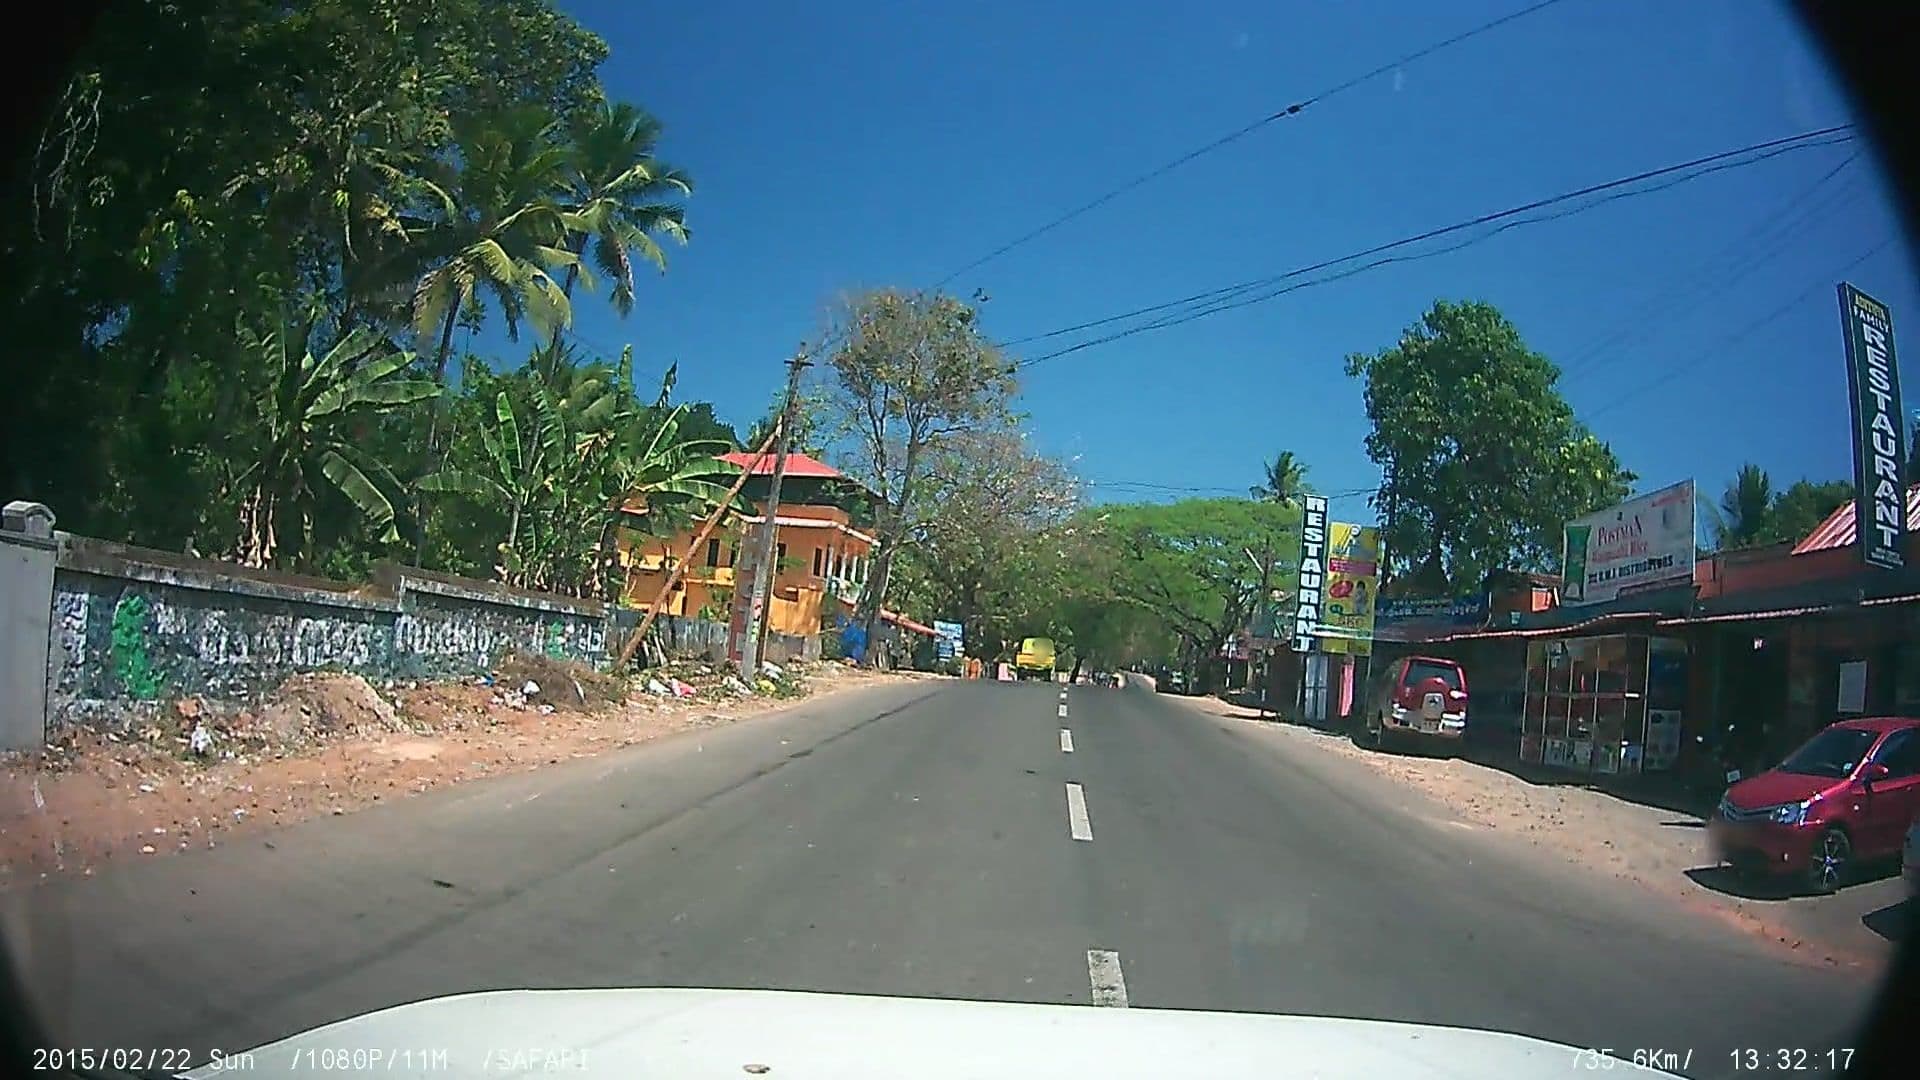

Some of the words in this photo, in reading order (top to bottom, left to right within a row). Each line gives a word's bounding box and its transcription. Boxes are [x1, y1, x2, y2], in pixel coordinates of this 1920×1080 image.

[1854, 305, 1889, 333] FAMILY
[1862, 322, 1899, 547] RESTAURANT
[1296, 497, 1326, 651] RESTAURANT
